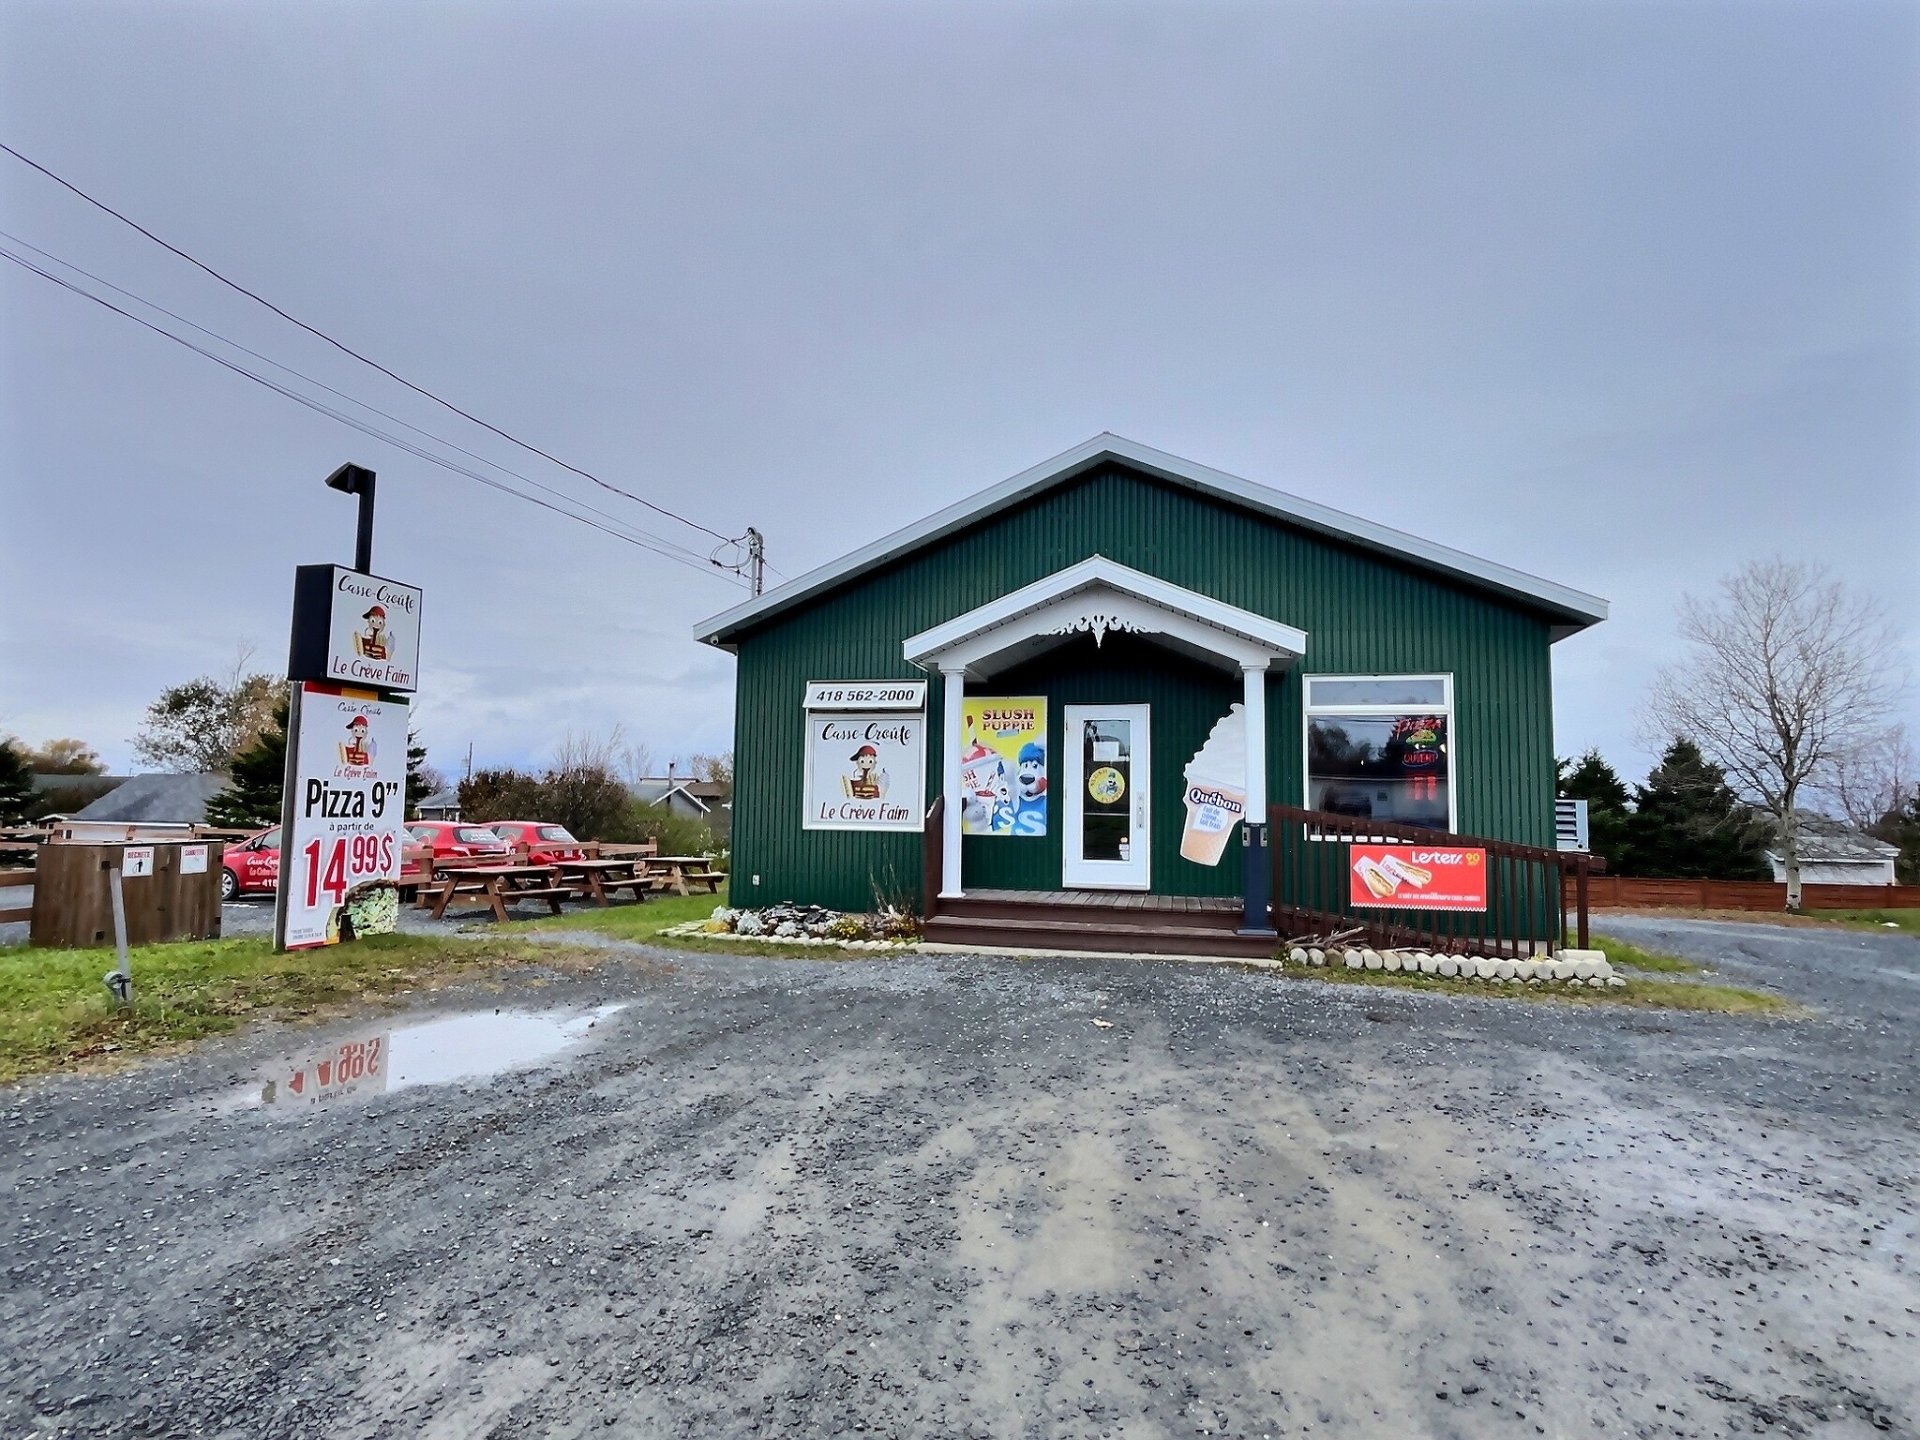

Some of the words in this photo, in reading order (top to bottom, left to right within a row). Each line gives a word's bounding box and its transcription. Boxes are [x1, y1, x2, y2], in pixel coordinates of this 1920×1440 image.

[338, 575, 415, 614] Casse-Croûte
[333, 656, 347, 674] Le
[351, 660, 382, 680] Crève
[385, 665, 410, 685] Faim
[816, 690, 843, 702] 418
[847, 689, 915, 702] 562-2000
[982, 709, 1035, 720] SLUSH
[822, 722, 912, 746] Casse-Croûte
[305, 778, 365, 818] Pizza
[820, 802, 835, 819] Le
[840, 802, 875, 820] Crève
[878, 802, 909, 821] Faim
[329, 822, 335, 831] à
[337, 822, 362, 833] partir
[363, 822, 374, 831] de
[1411, 851, 1463, 865] Lesters
